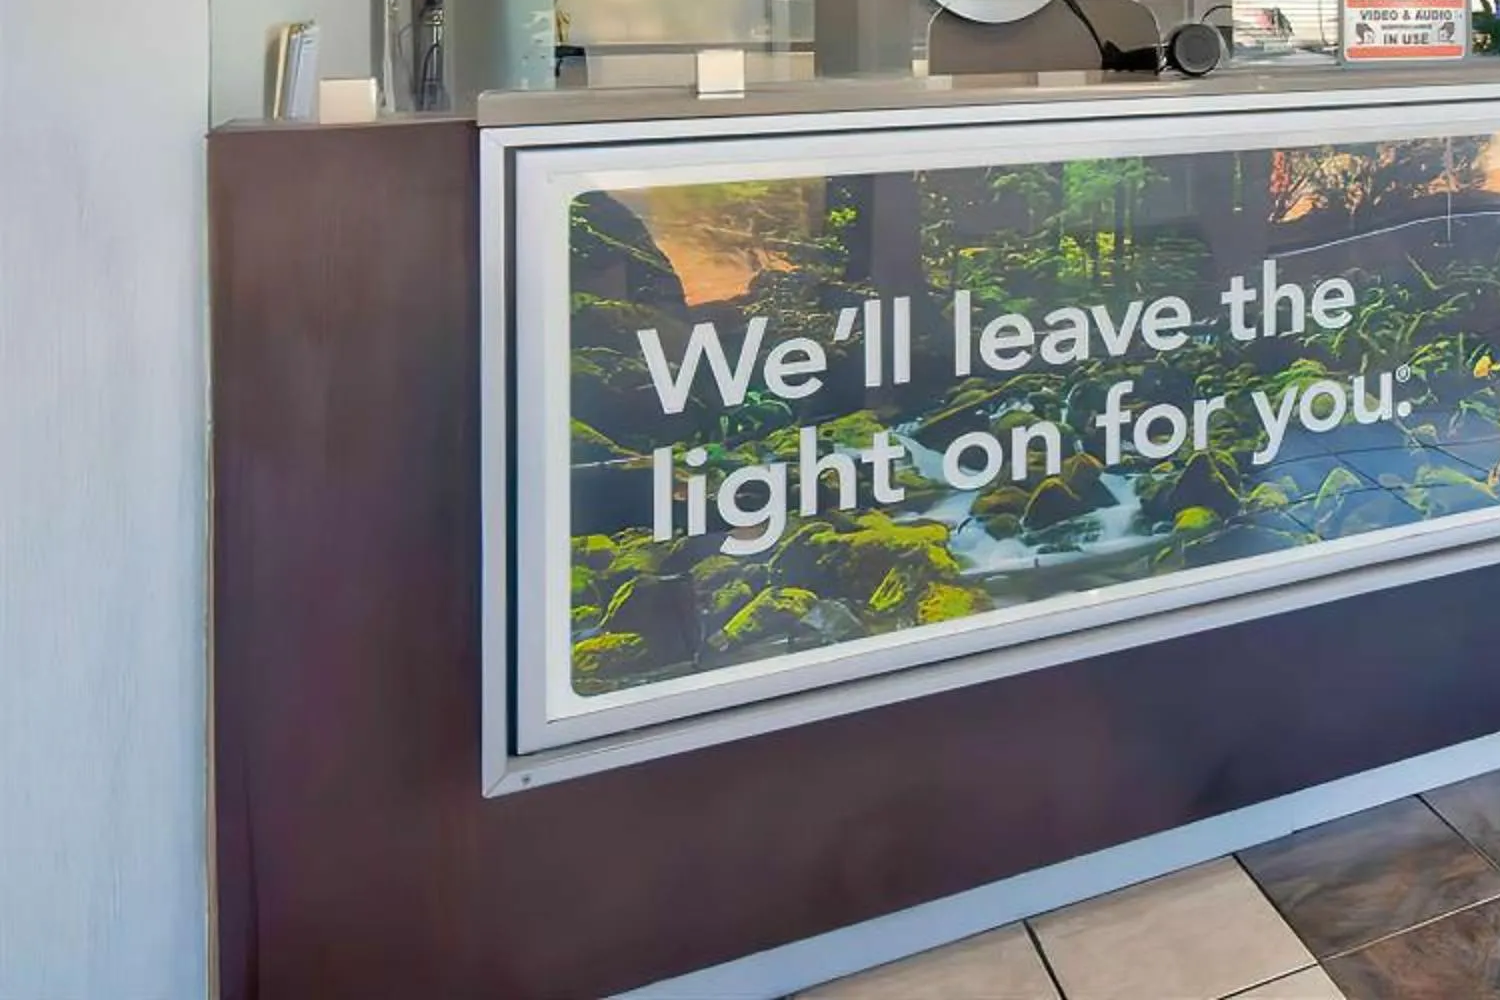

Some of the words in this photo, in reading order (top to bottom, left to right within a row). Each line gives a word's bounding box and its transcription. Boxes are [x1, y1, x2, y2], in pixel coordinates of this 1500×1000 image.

[1360, 10, 1401, 21] VIDEO
[1402, 10, 1412, 21] &
[1415, 10, 1453, 21] AUDIO
[1383, 33, 1397, 45] IN
[1402, 32, 1430, 45] USE
[638, 293, 911, 416] We'll
[954, 290, 1191, 377] leave
[1221, 259, 1356, 342] the
[651, 424, 906, 557] light
[943, 419, 1062, 492] on
[1096, 380, 1227, 465] for
